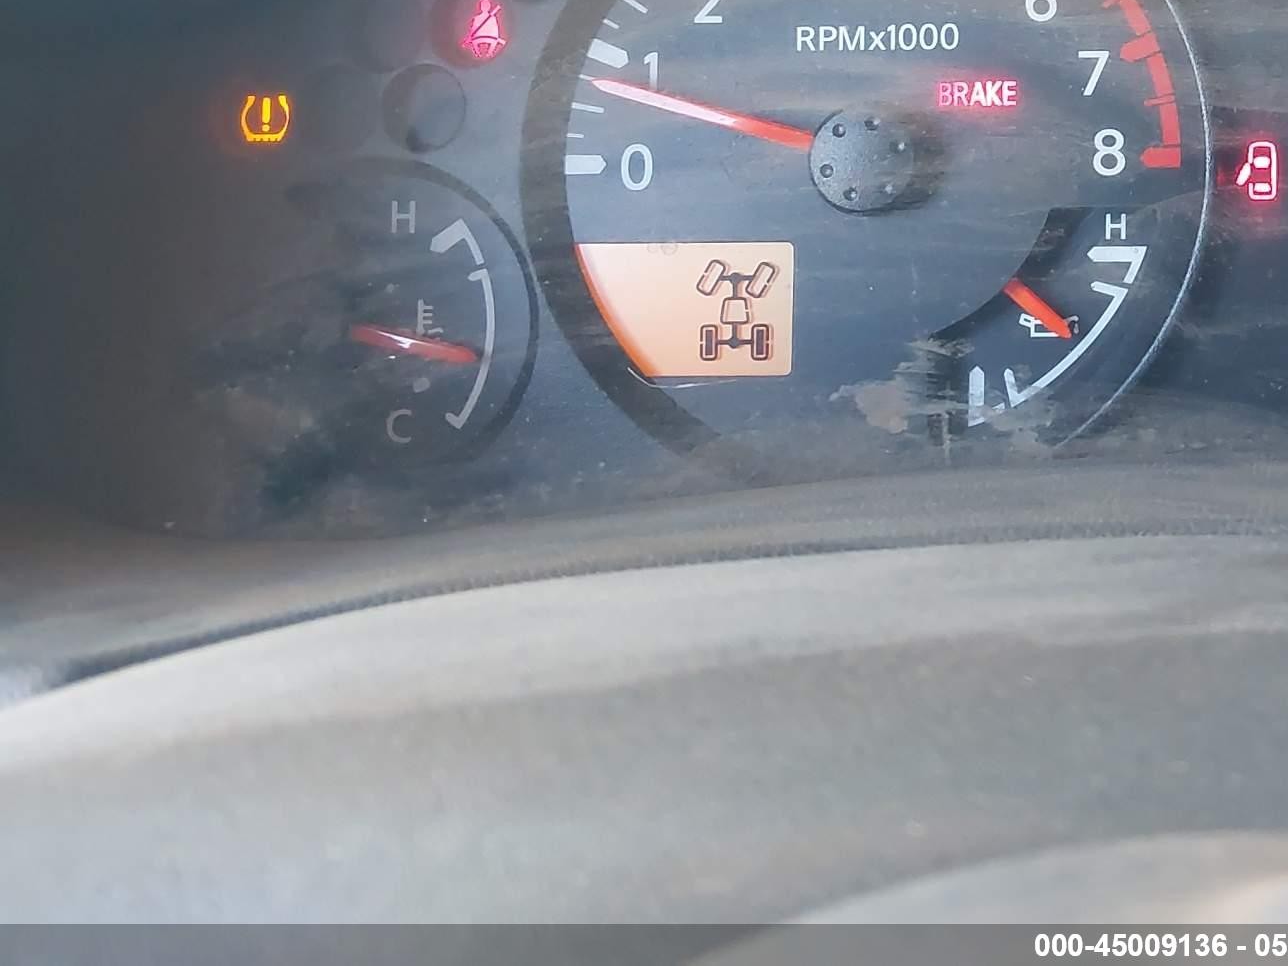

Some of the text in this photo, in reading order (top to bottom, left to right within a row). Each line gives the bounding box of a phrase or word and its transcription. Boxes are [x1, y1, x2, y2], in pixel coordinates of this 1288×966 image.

[796, 24, 960, 51] RPMx1000
[643, 52, 658, 88] 1
[1078, 51, 1110, 96] 7
[938, 81, 1017, 107] BRAKE
[620, 144, 653, 190] 0
[1093, 129, 1125, 175] 8
[391, 200, 416, 234] H
[1105, 214, 1126, 239] H
[386, 409, 413, 443] C
